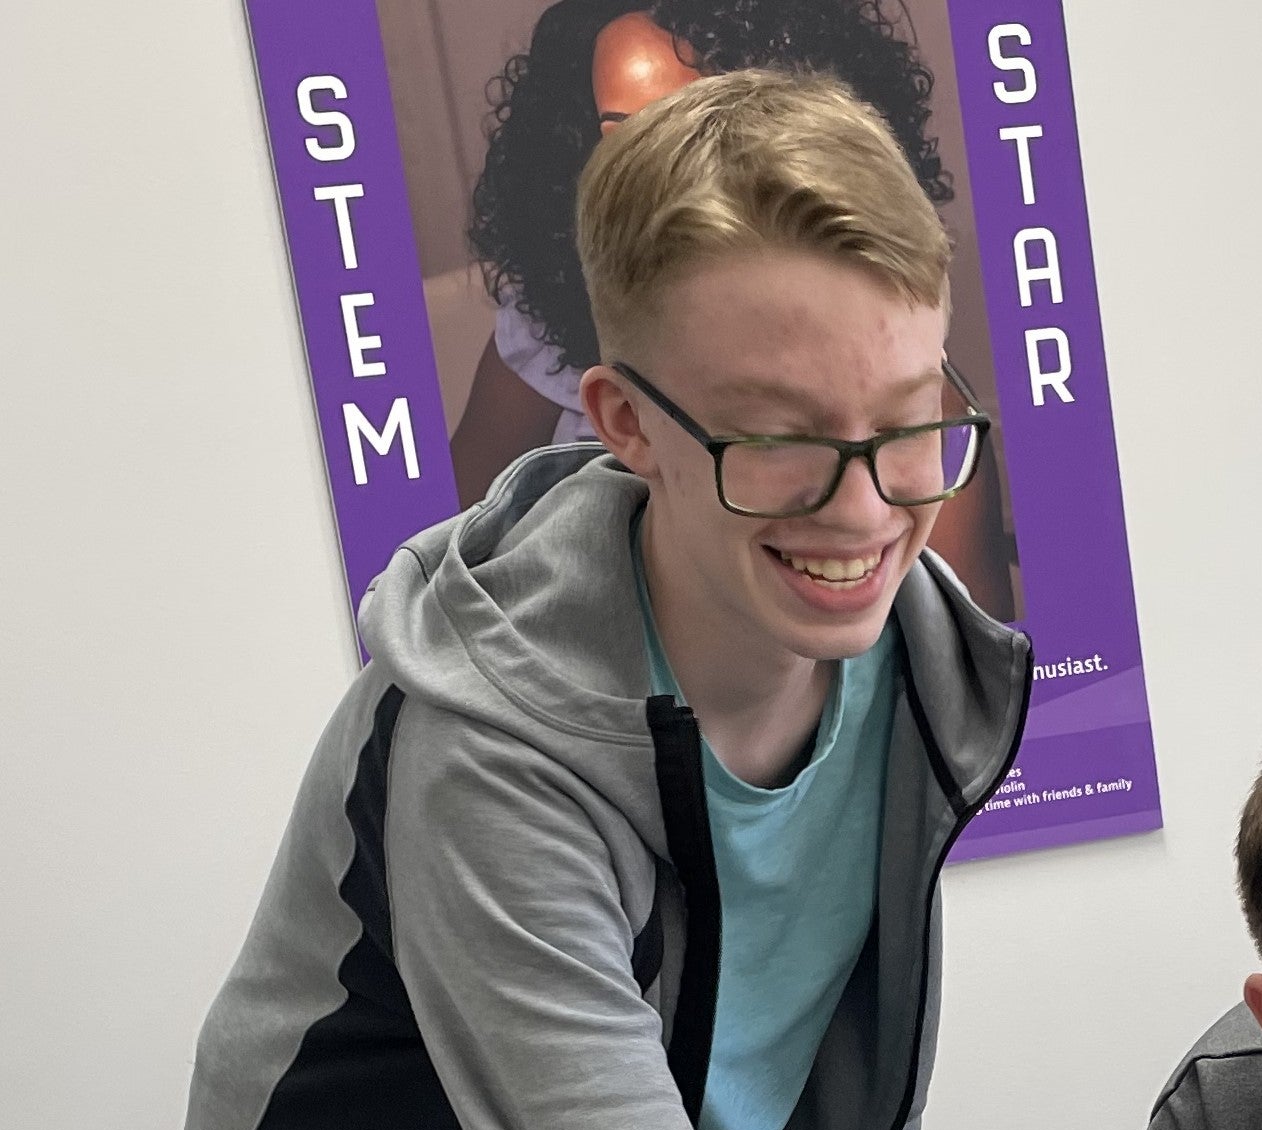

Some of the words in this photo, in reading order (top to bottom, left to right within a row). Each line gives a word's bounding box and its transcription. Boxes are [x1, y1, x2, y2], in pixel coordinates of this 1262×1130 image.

[296, 74, 421, 486] STEM
[987, 23, 1075, 407] STAR
[985, 798, 1012, 811] time
[1013, 792, 1040, 807] with
[1042, 785, 1082, 802] friends
[1084, 783, 1094, 795] &
[1096, 778, 1133, 794] family
